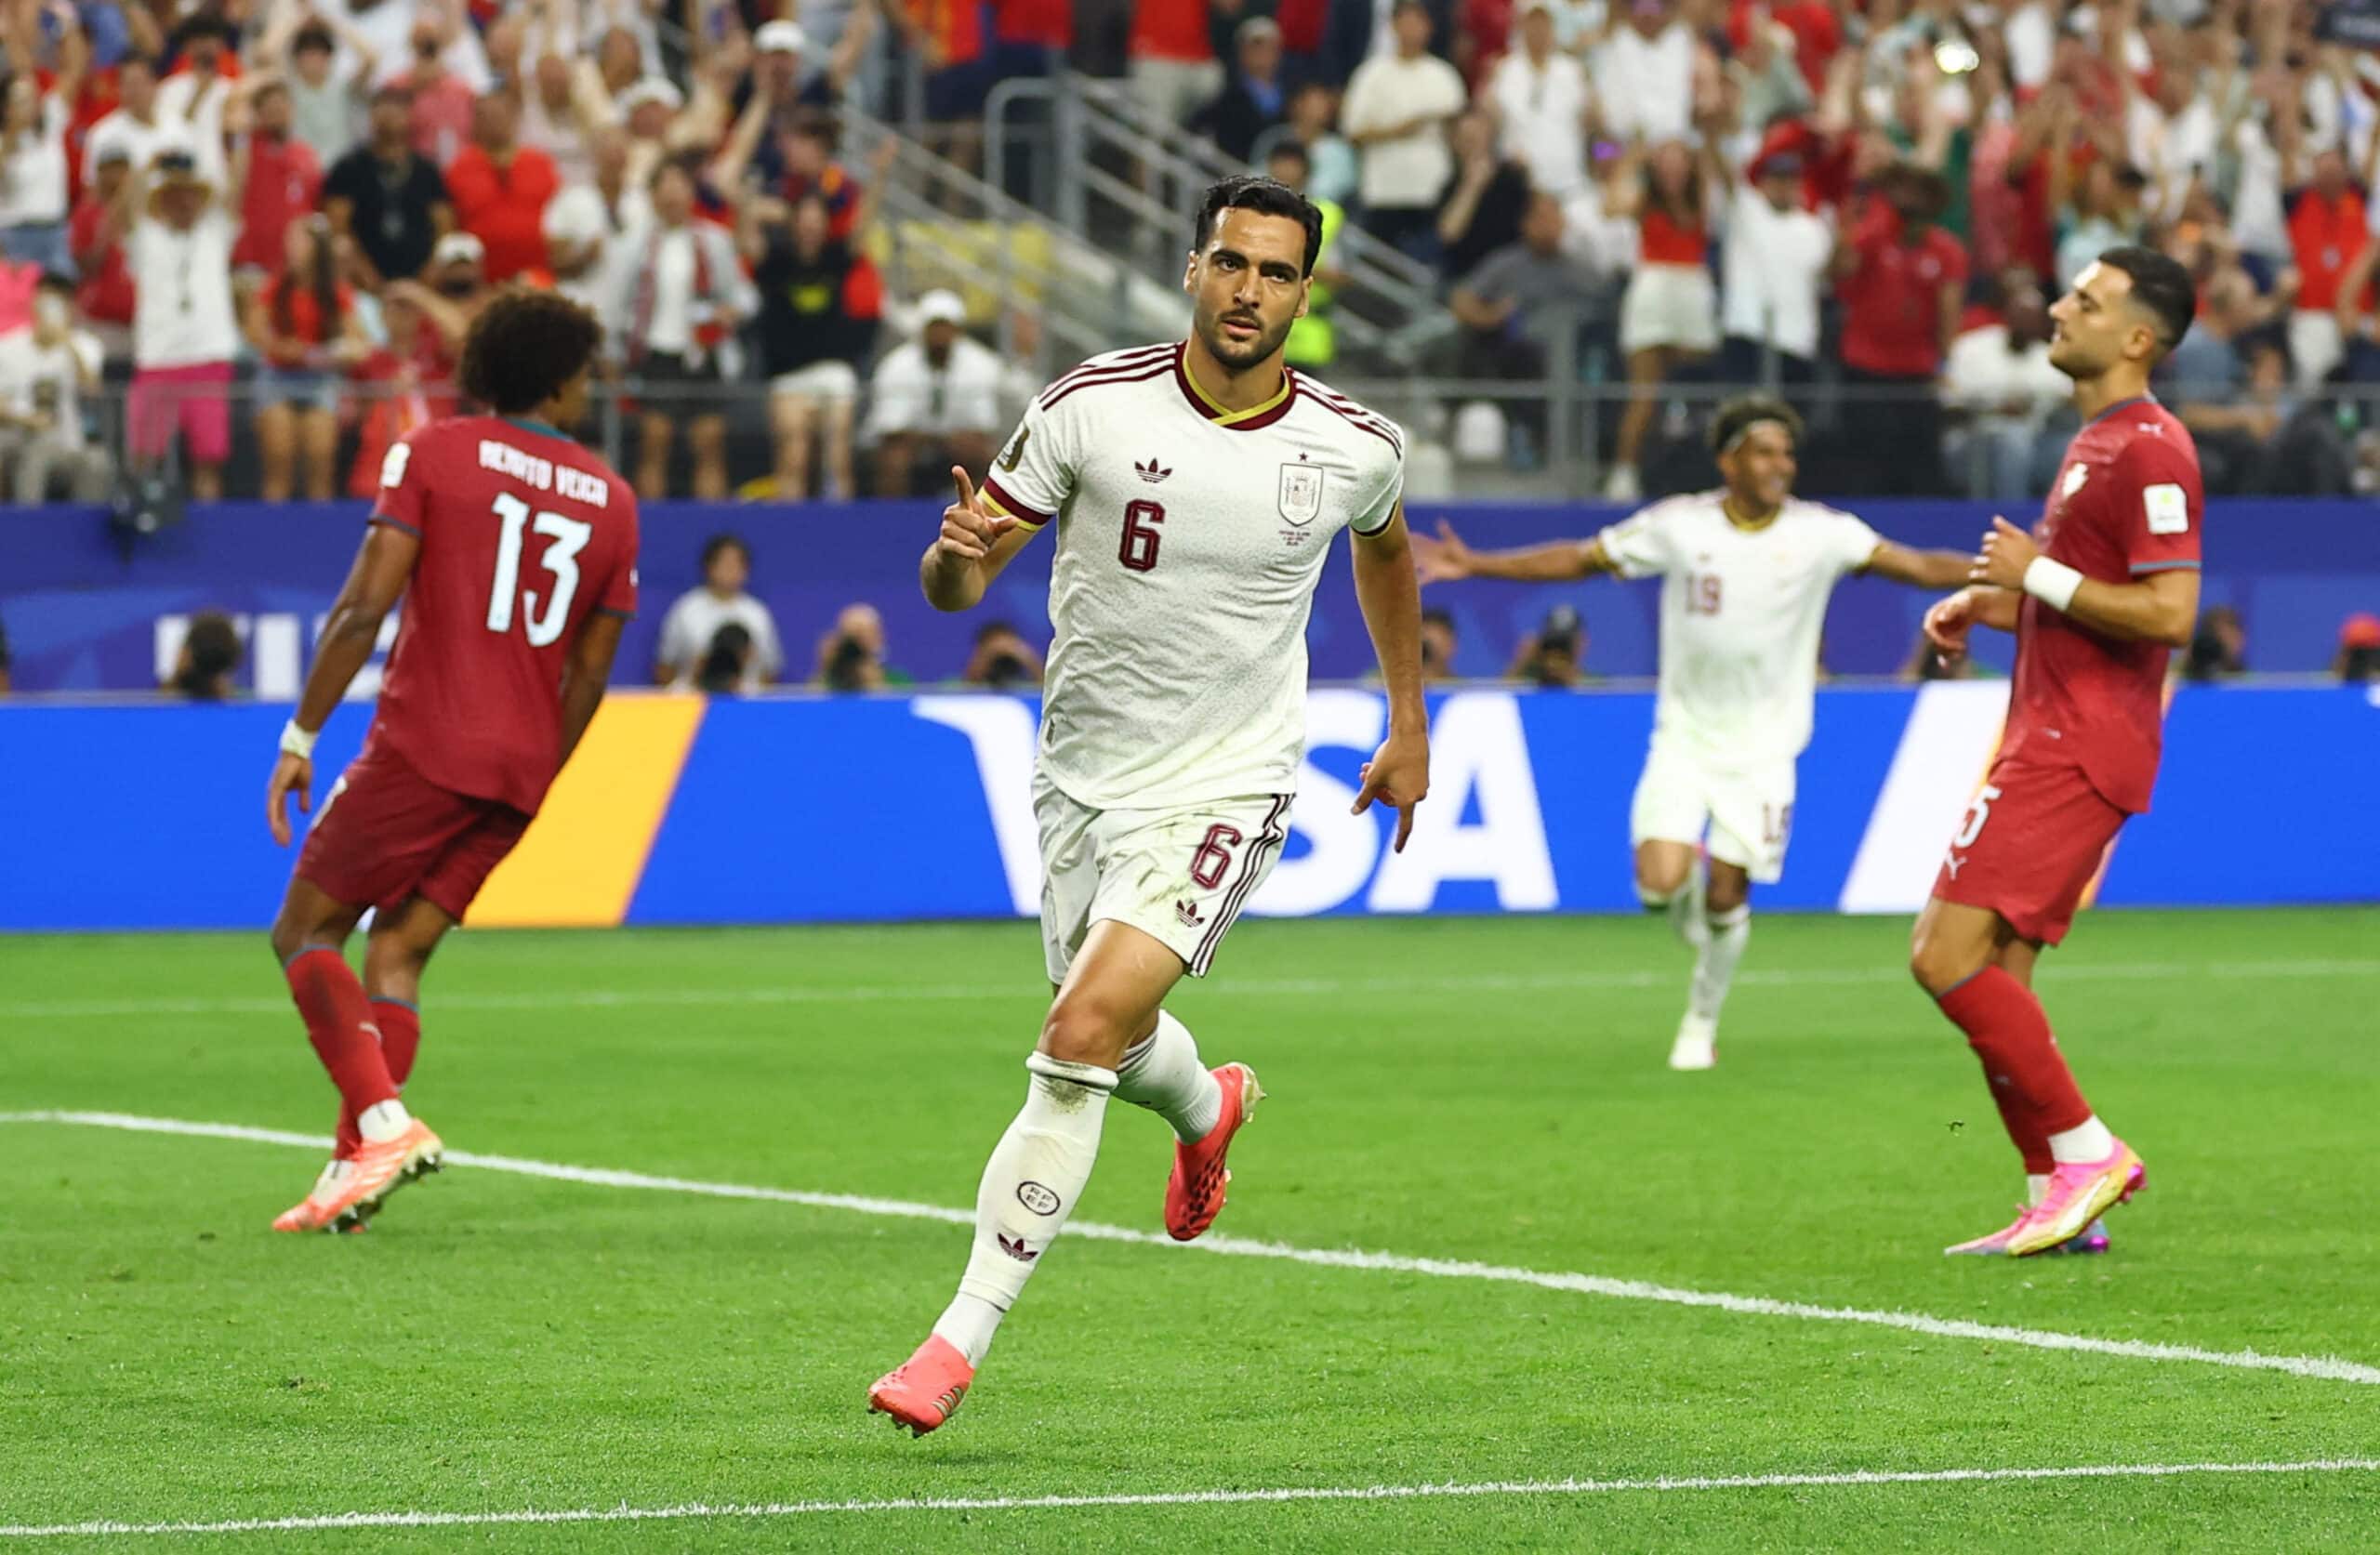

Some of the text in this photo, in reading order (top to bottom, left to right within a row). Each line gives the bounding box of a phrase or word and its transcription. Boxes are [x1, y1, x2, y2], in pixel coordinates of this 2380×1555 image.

[486, 492, 592, 647] 13
[1117, 498, 1167, 573] 6
[1686, 573, 1722, 616] 19
[909, 691, 1559, 917] VSA
[1190, 824, 1244, 890] 6
